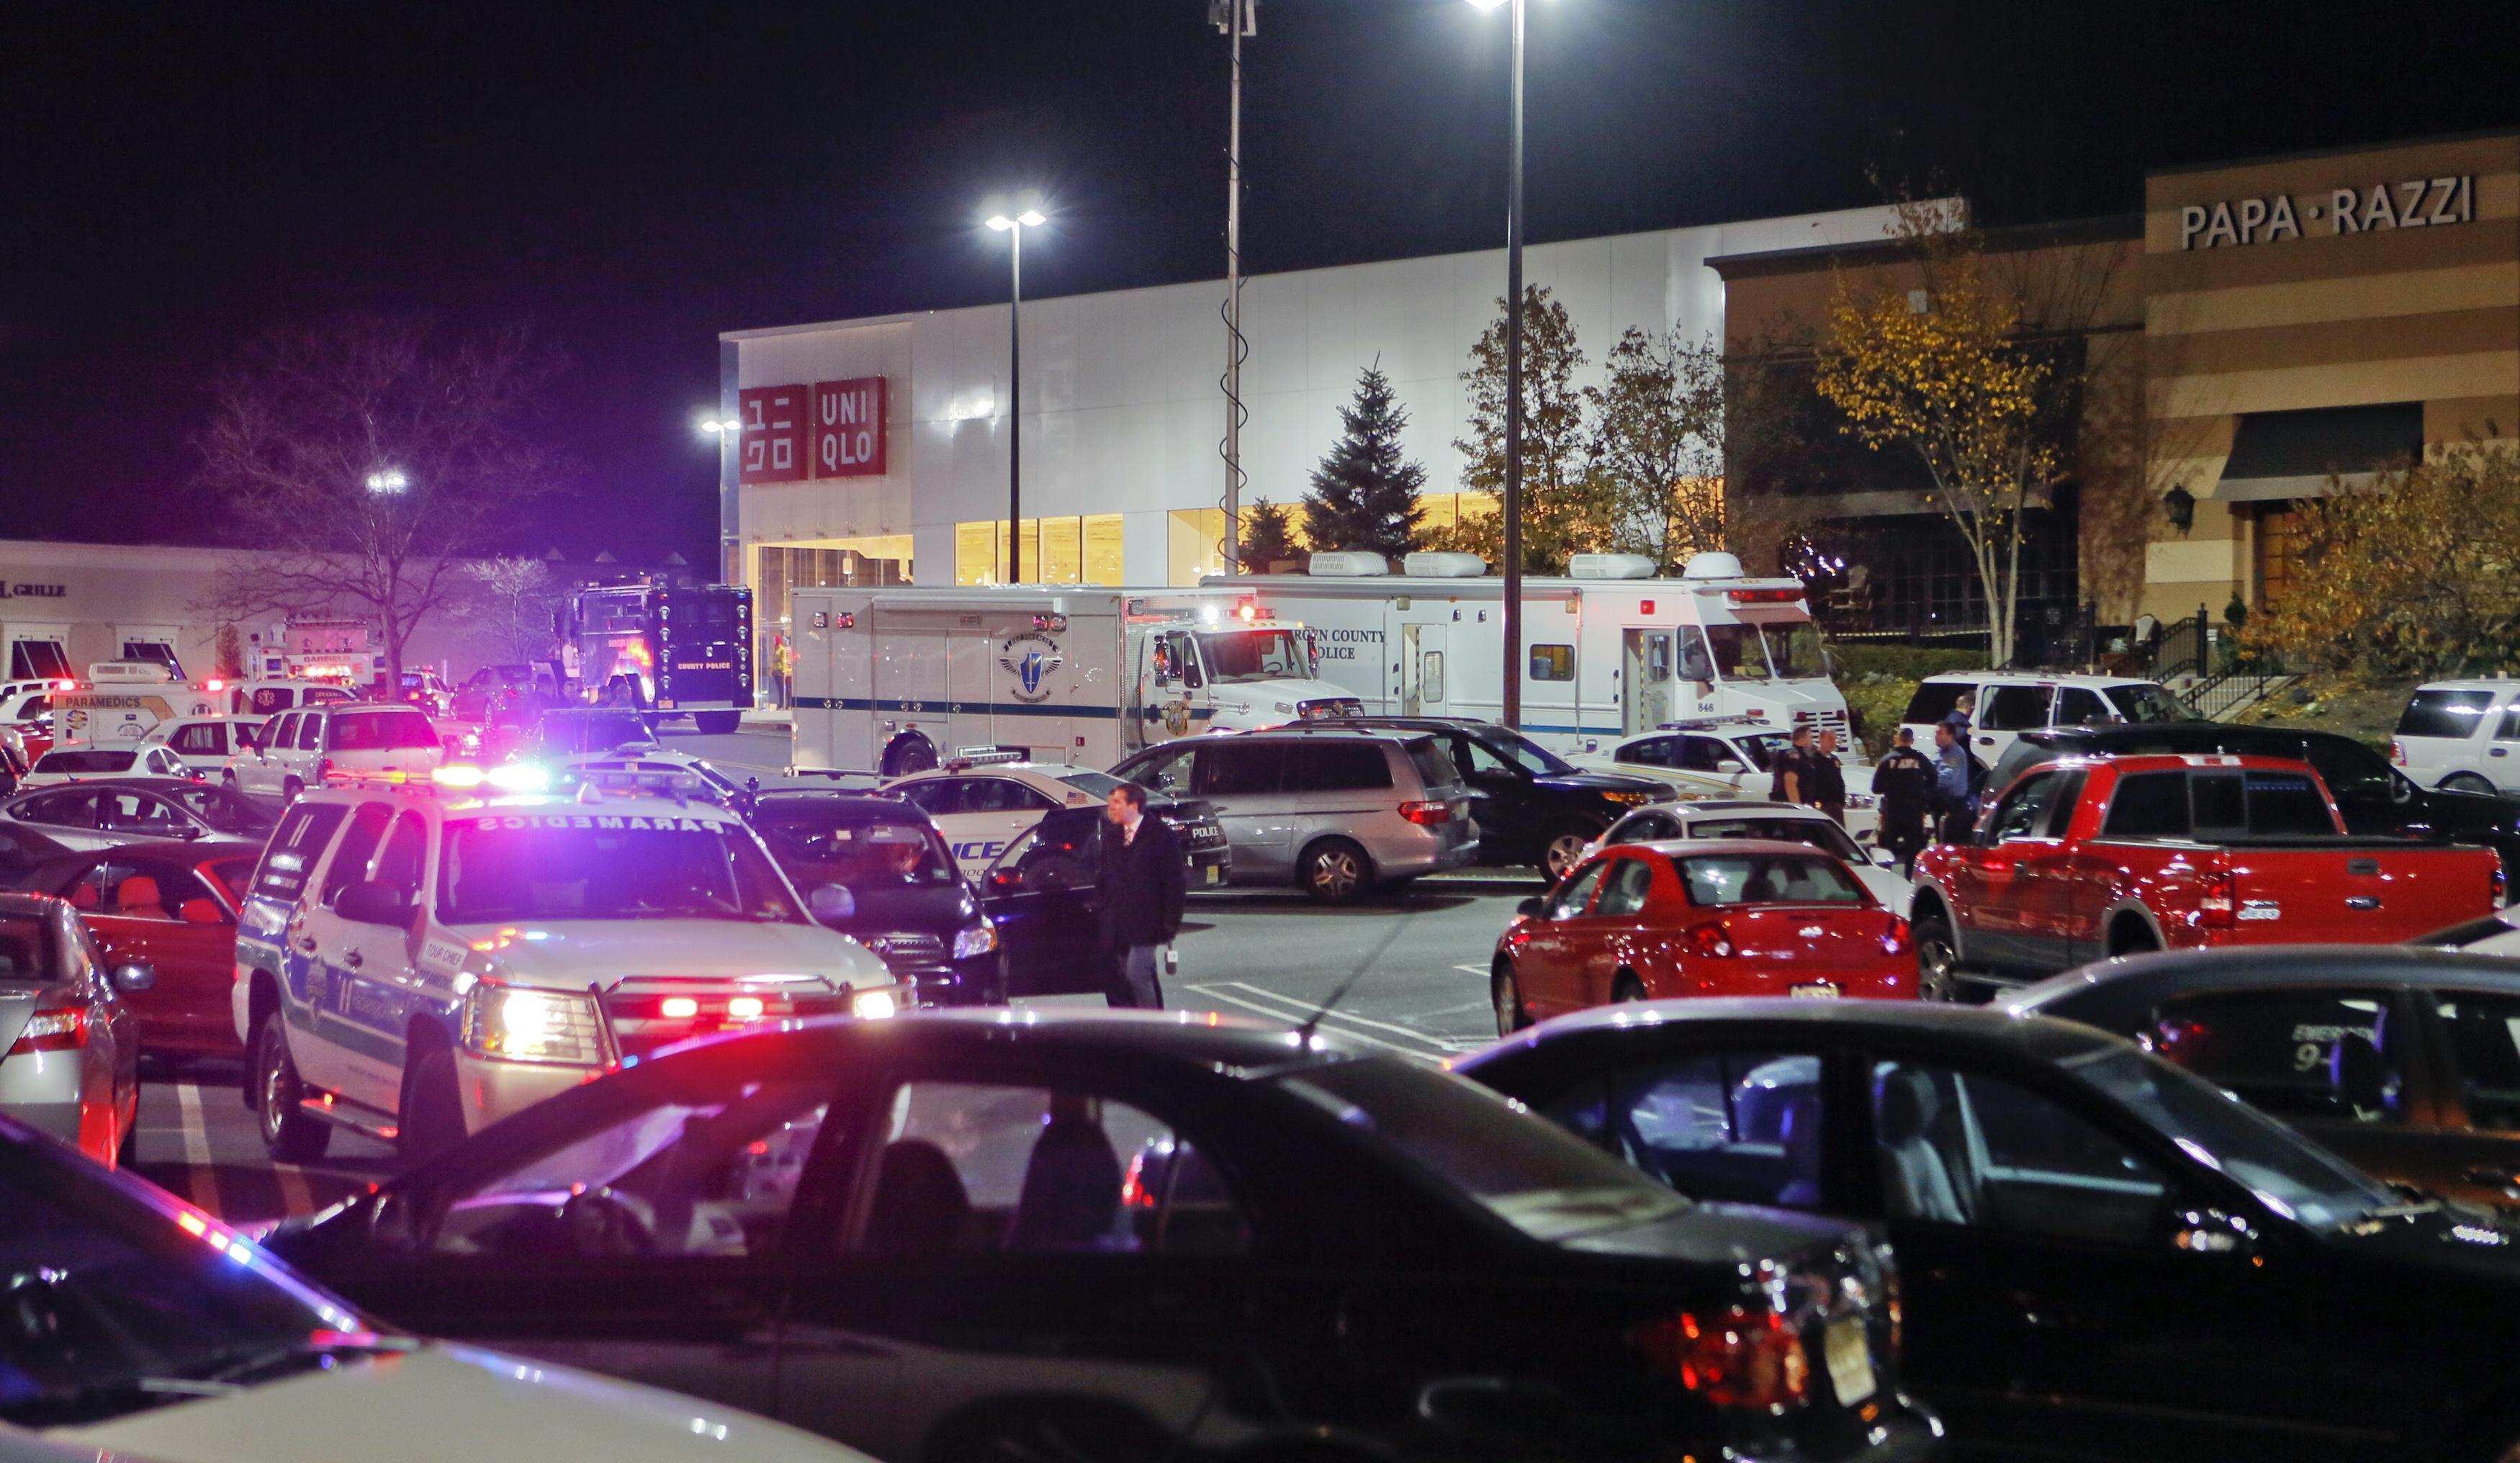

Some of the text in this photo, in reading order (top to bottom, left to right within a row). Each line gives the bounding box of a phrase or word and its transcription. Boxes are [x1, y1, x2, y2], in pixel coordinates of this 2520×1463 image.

[2182, 176, 2474, 251] PAPA RAZZI
[822, 390, 866, 426] UNI
[822, 431, 871, 472] QLO
[13, 584, 66, 598] GRILLE
[1331, 629, 1385, 642] COUNTY
[1318, 647, 1355, 660] OLICE
[66, 697, 141, 708] PARAMEDICS
[1698, 702, 1714, 713] 846
[1192, 827, 1219, 839] POLICE
[952, 841, 1006, 860] ICE
[426, 942, 464, 966] TOUR CHIEF
